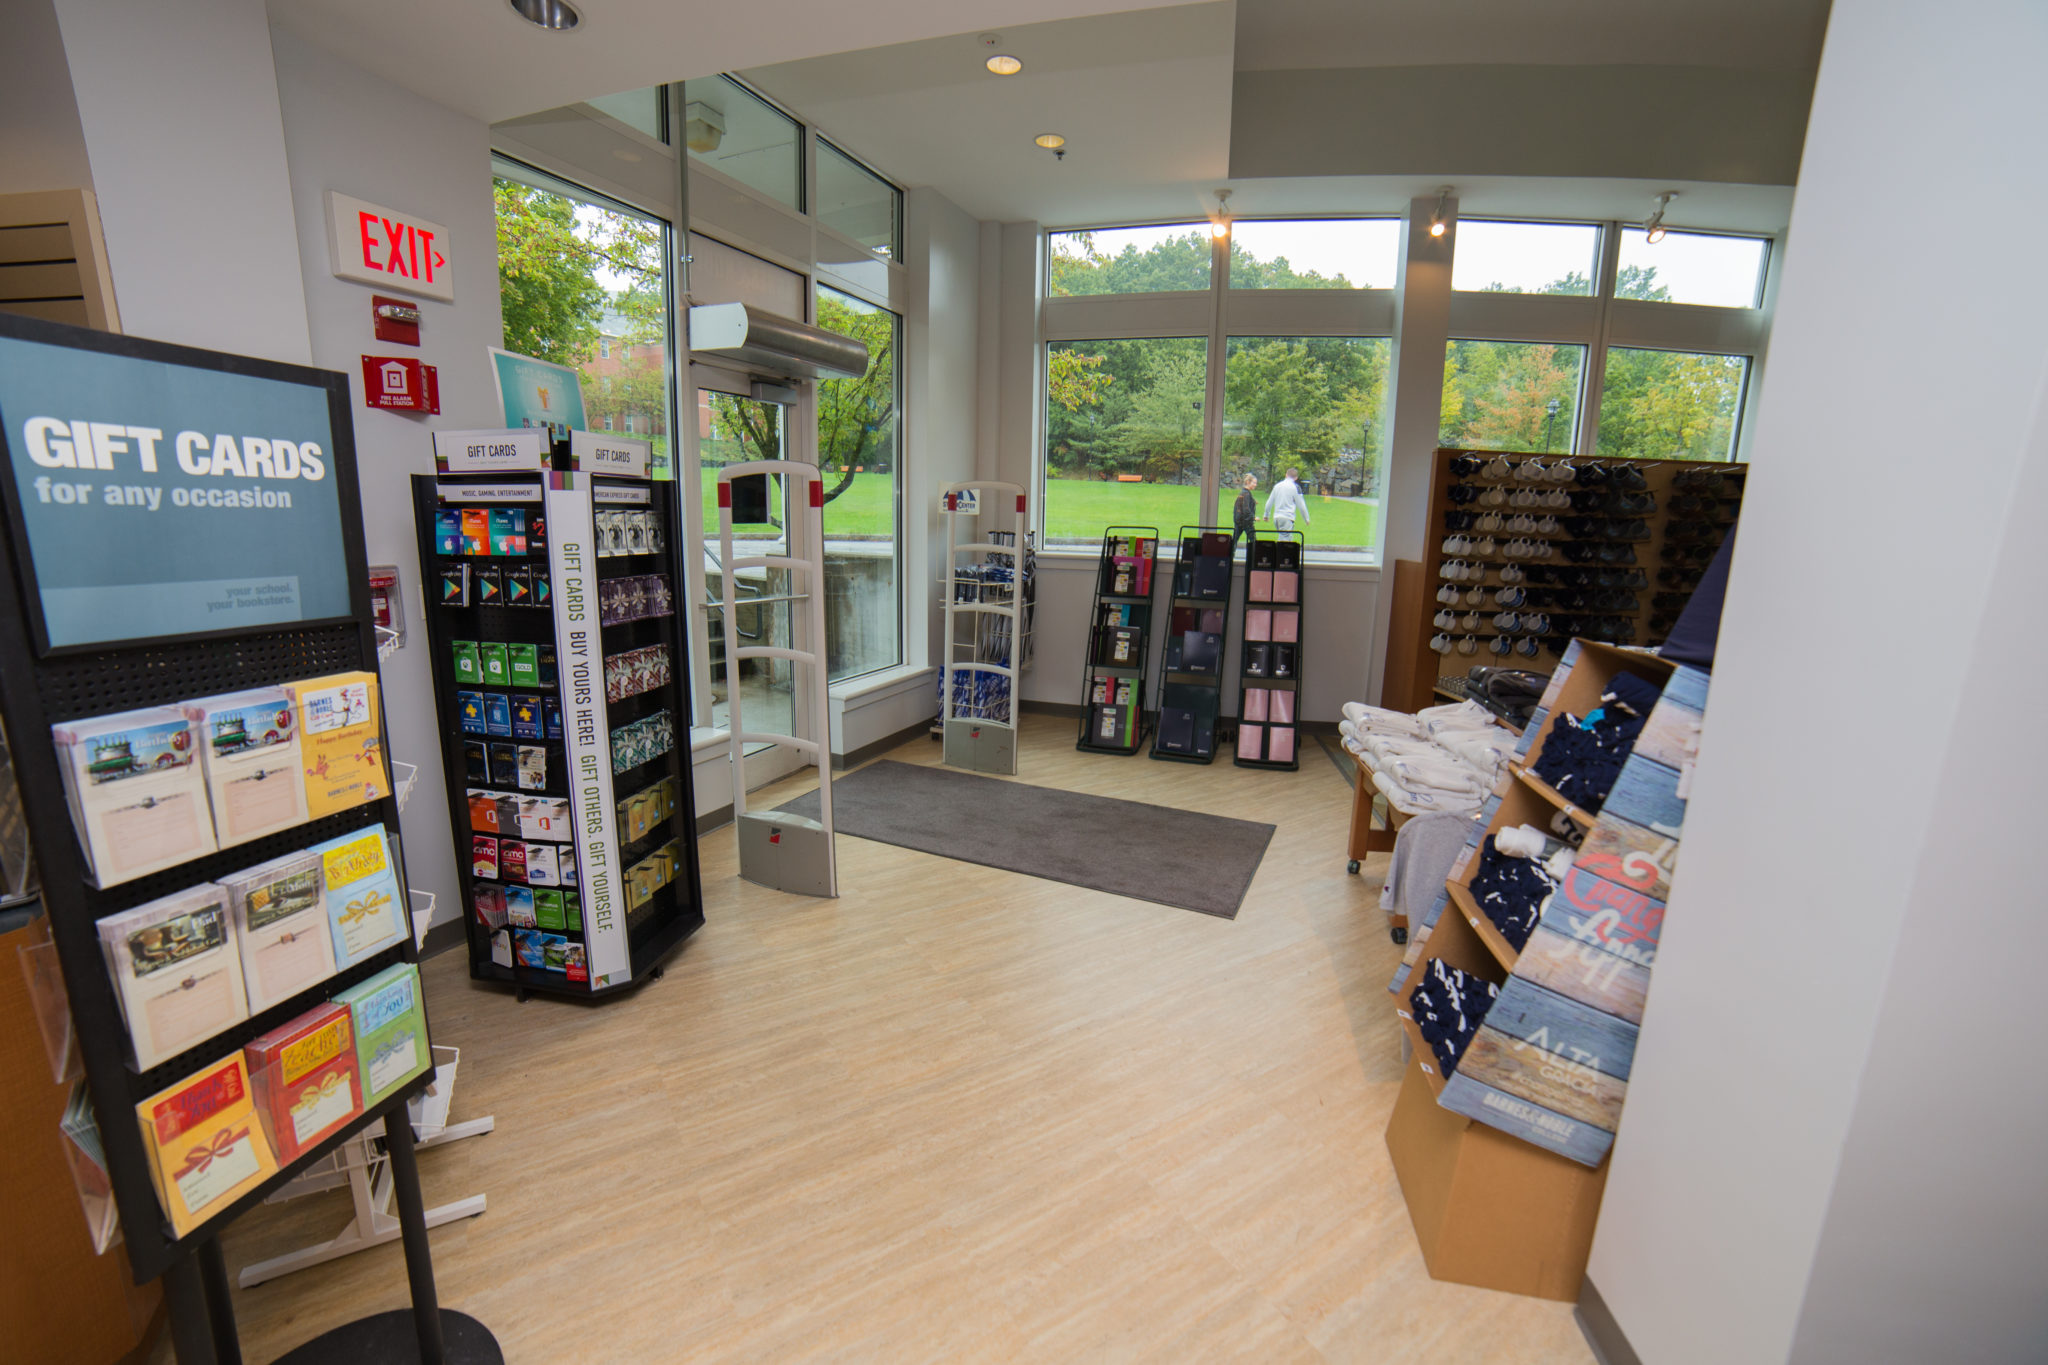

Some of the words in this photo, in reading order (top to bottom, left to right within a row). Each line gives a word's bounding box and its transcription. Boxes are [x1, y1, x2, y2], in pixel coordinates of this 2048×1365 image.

[358, 210, 434, 284] EXIT
[24, 416, 163, 472] GIFT
[175, 430, 325, 481] CARDS
[467, 446, 485, 457] GIFT
[489, 444, 516, 456] CARDS
[596, 449, 609, 460] GIFT
[611, 450, 630, 463] CARDS
[34, 476, 92, 504] for
[104, 484, 162, 511] any
[171, 487, 292, 508] occasion
[532, 522, 545, 536] $2
[563, 543, 581, 572] GIFT
[207, 600, 233, 613] your
[237, 595, 295, 608] bookstore.
[226, 587, 251, 599] your
[255, 583, 293, 595] school.
[566, 578, 585, 621] CARDS
[570, 632, 588, 656] BUY
[573, 661, 592, 705] YOURS
[309, 697, 332, 708] BARNES
[576, 709, 595, 746] HERE!
[580, 754, 599, 782] GIFT
[584, 786, 603, 839] OTHERS.
[473, 847, 496, 856] amc
[503, 850, 523, 858] amc
[589, 841, 606, 867] GIFT
[592, 870, 613, 934] YOURSELF.
[1514, 1026, 1600, 1084] ALTA
[1540, 1066, 1598, 1098] GRACIA
